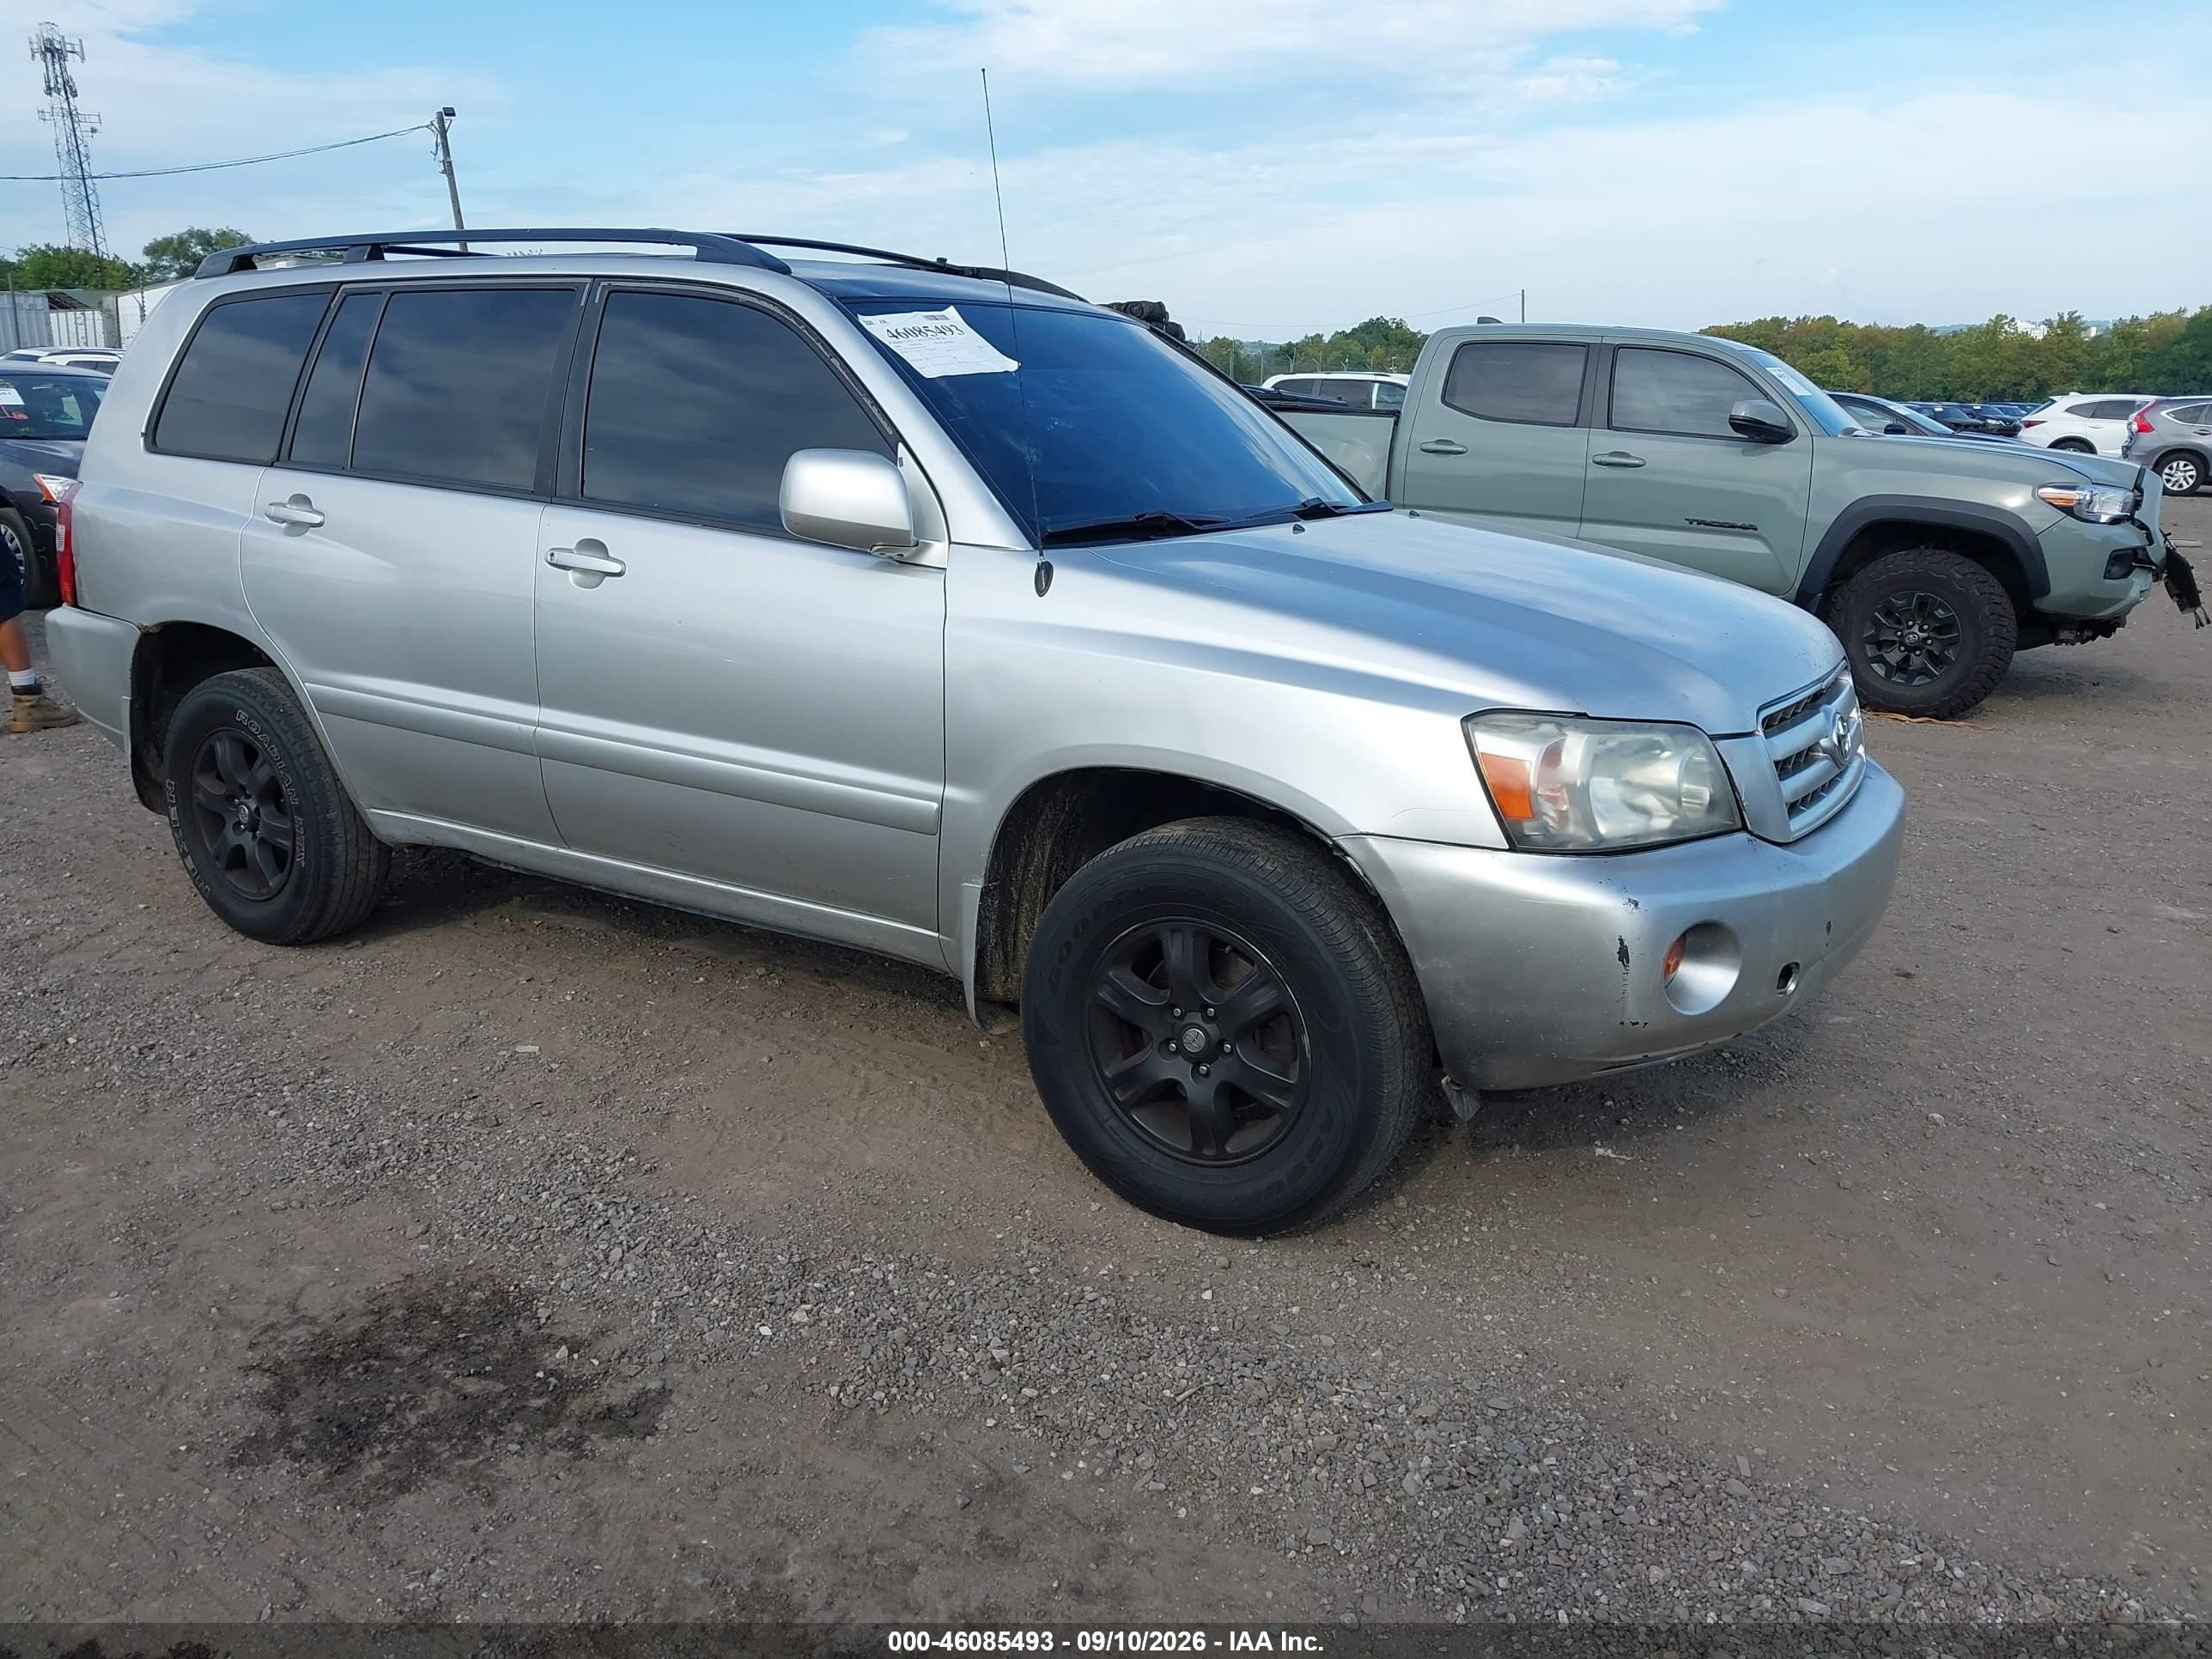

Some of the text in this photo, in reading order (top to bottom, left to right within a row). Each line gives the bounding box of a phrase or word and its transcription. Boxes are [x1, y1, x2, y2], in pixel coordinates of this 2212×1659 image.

[886, 325, 965, 339] 46085493
[1684, 517, 1758, 531] TACOMA
[235, 709, 299, 805] ROADIAN
